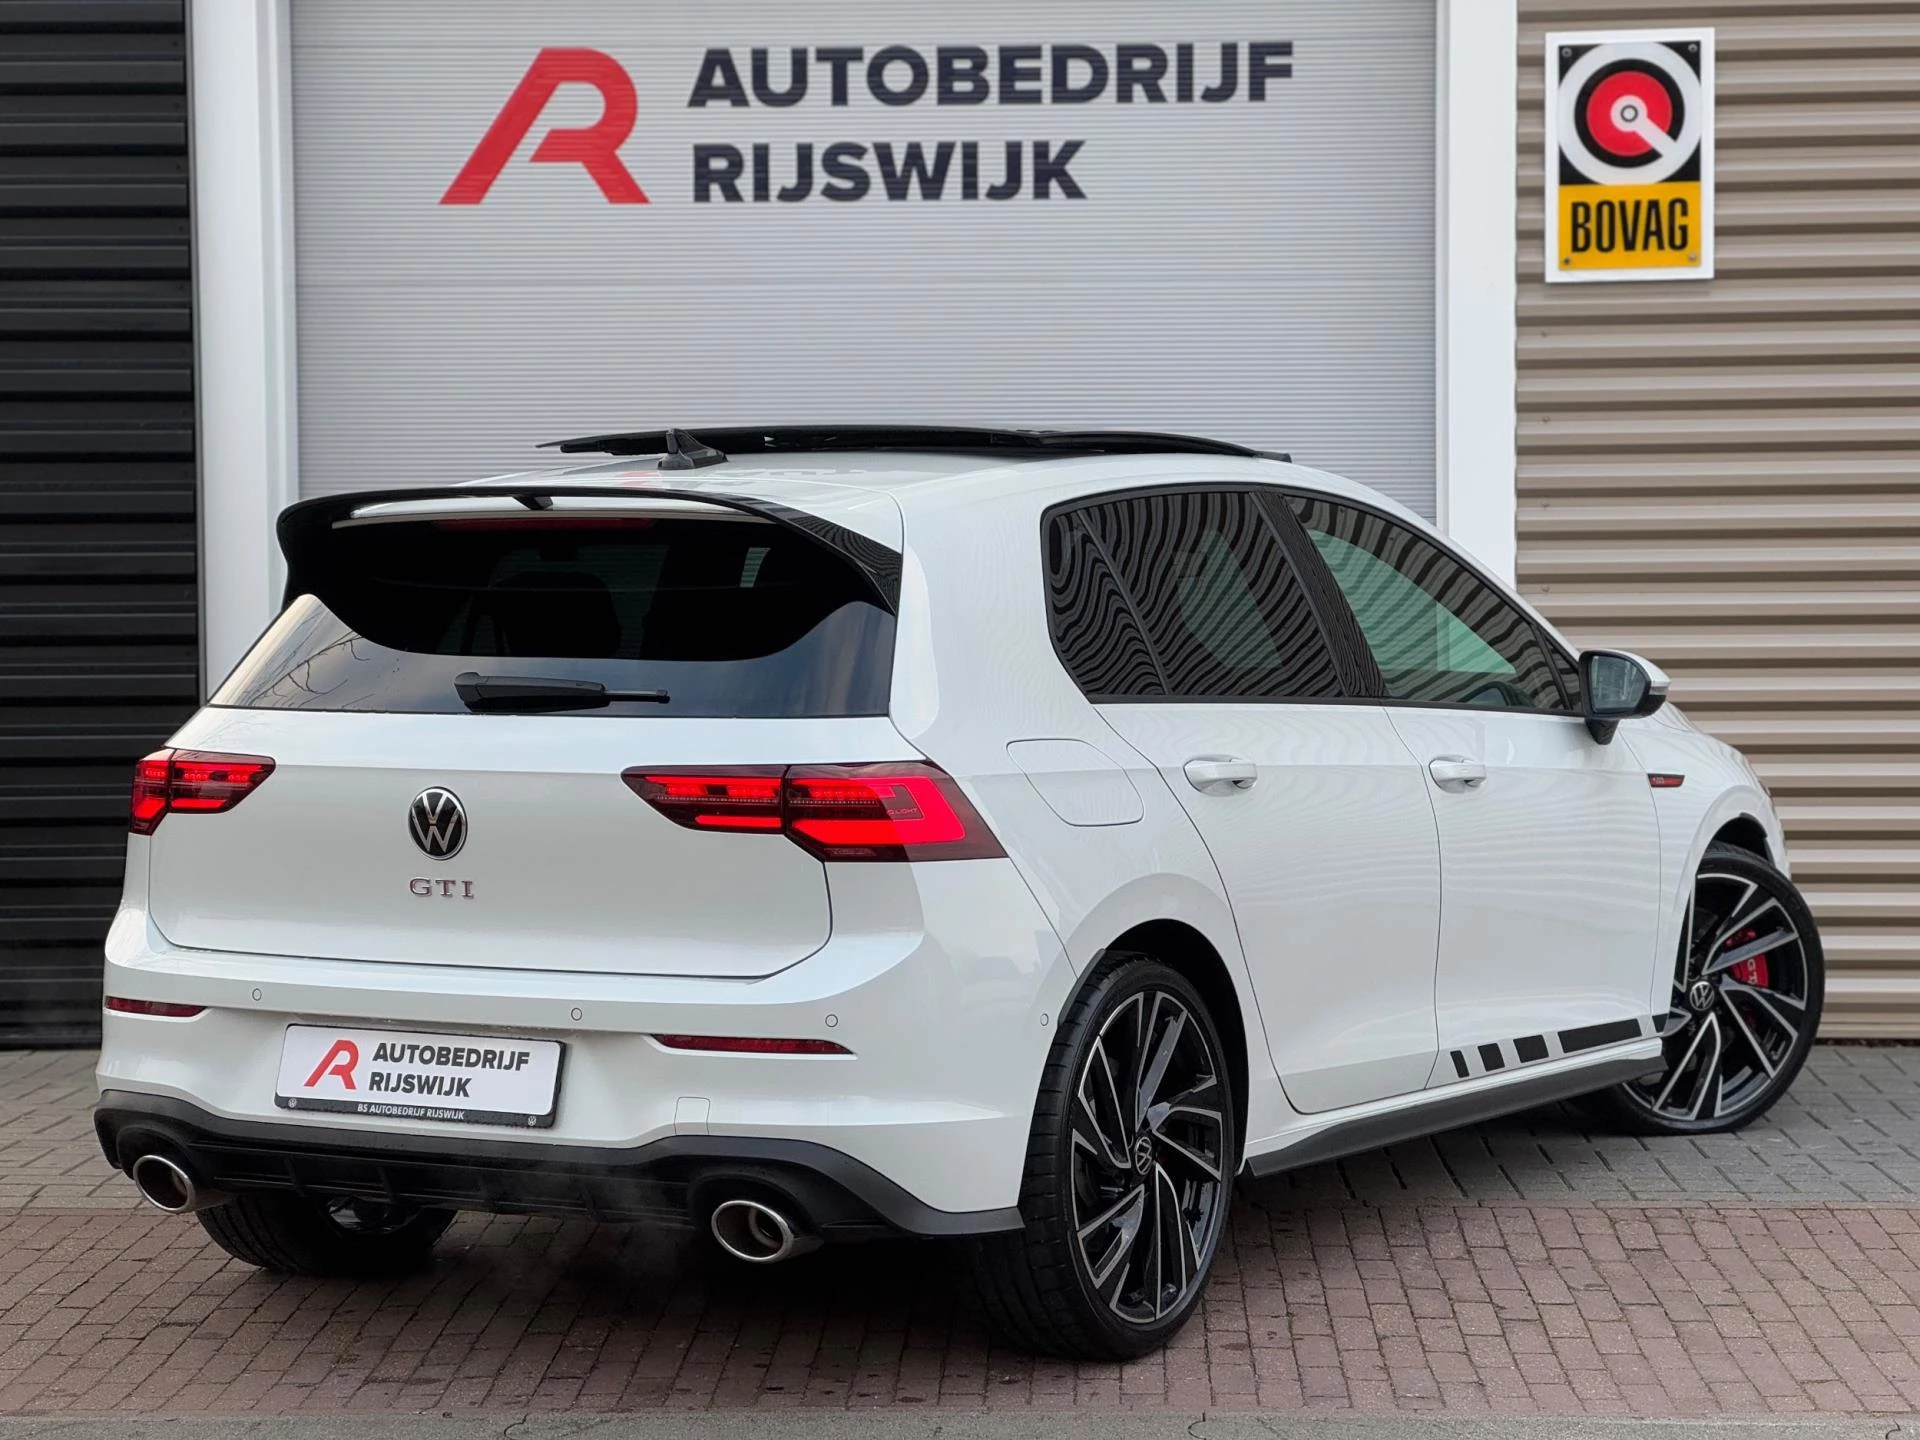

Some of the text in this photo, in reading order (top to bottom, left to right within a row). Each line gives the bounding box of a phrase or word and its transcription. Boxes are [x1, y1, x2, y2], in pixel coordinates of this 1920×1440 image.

[687, 41, 1294, 108] AUTOBEDRIJF
[692, 140, 1087, 203] RIJSWIJK
[1570, 197, 1689, 253] BOVAG
[409, 878, 474, 898] GTI
[372, 1042, 530, 1071] AUTOBEDRIJF
[369, 1072, 472, 1097] RIJSWIJK
[357, 1103, 465, 1120] BS AUTOBEDRIJF RIJSWIJK
